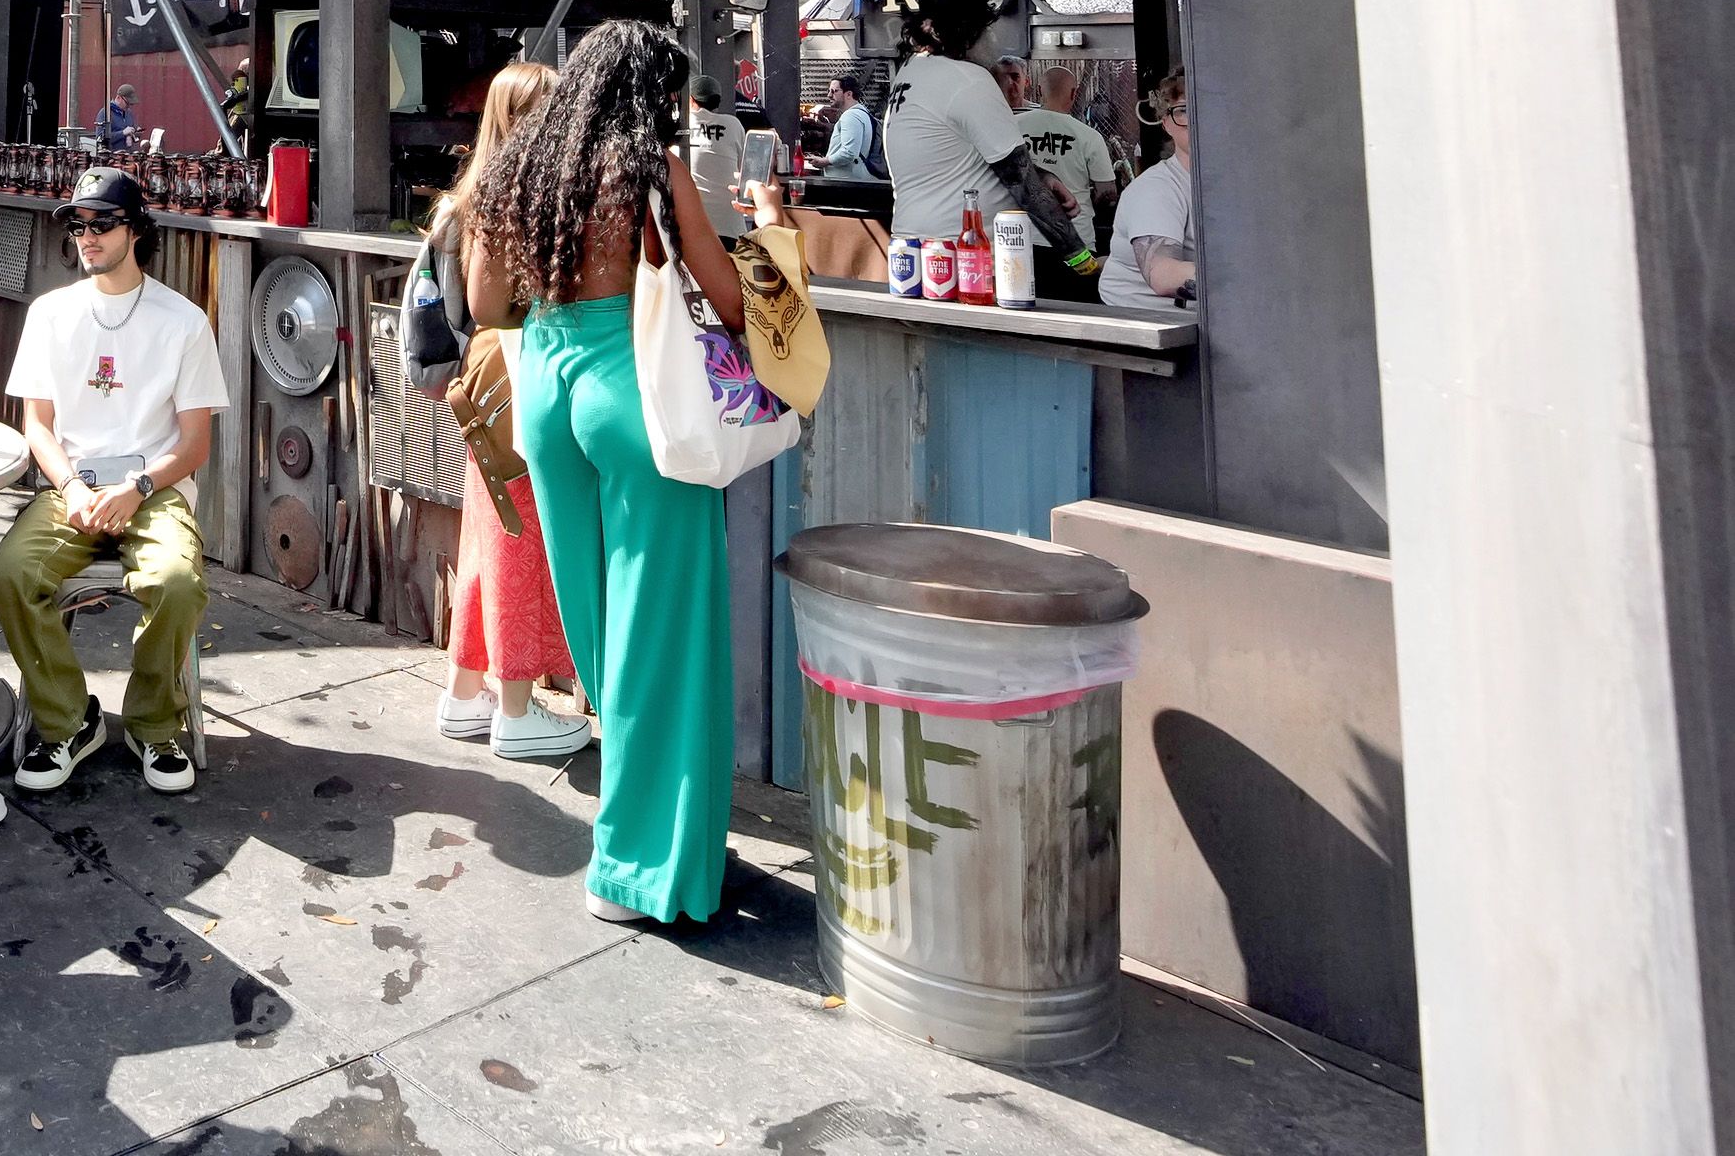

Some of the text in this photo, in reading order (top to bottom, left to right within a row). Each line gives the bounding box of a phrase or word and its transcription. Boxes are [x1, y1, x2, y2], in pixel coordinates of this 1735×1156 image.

[995, 221, 1024, 237] Liquid
[997, 234, 1026, 247] Death
[892, 257, 911, 266] LONE
[929, 259, 949, 268] LONE
[929, 266, 949, 274] STAR
